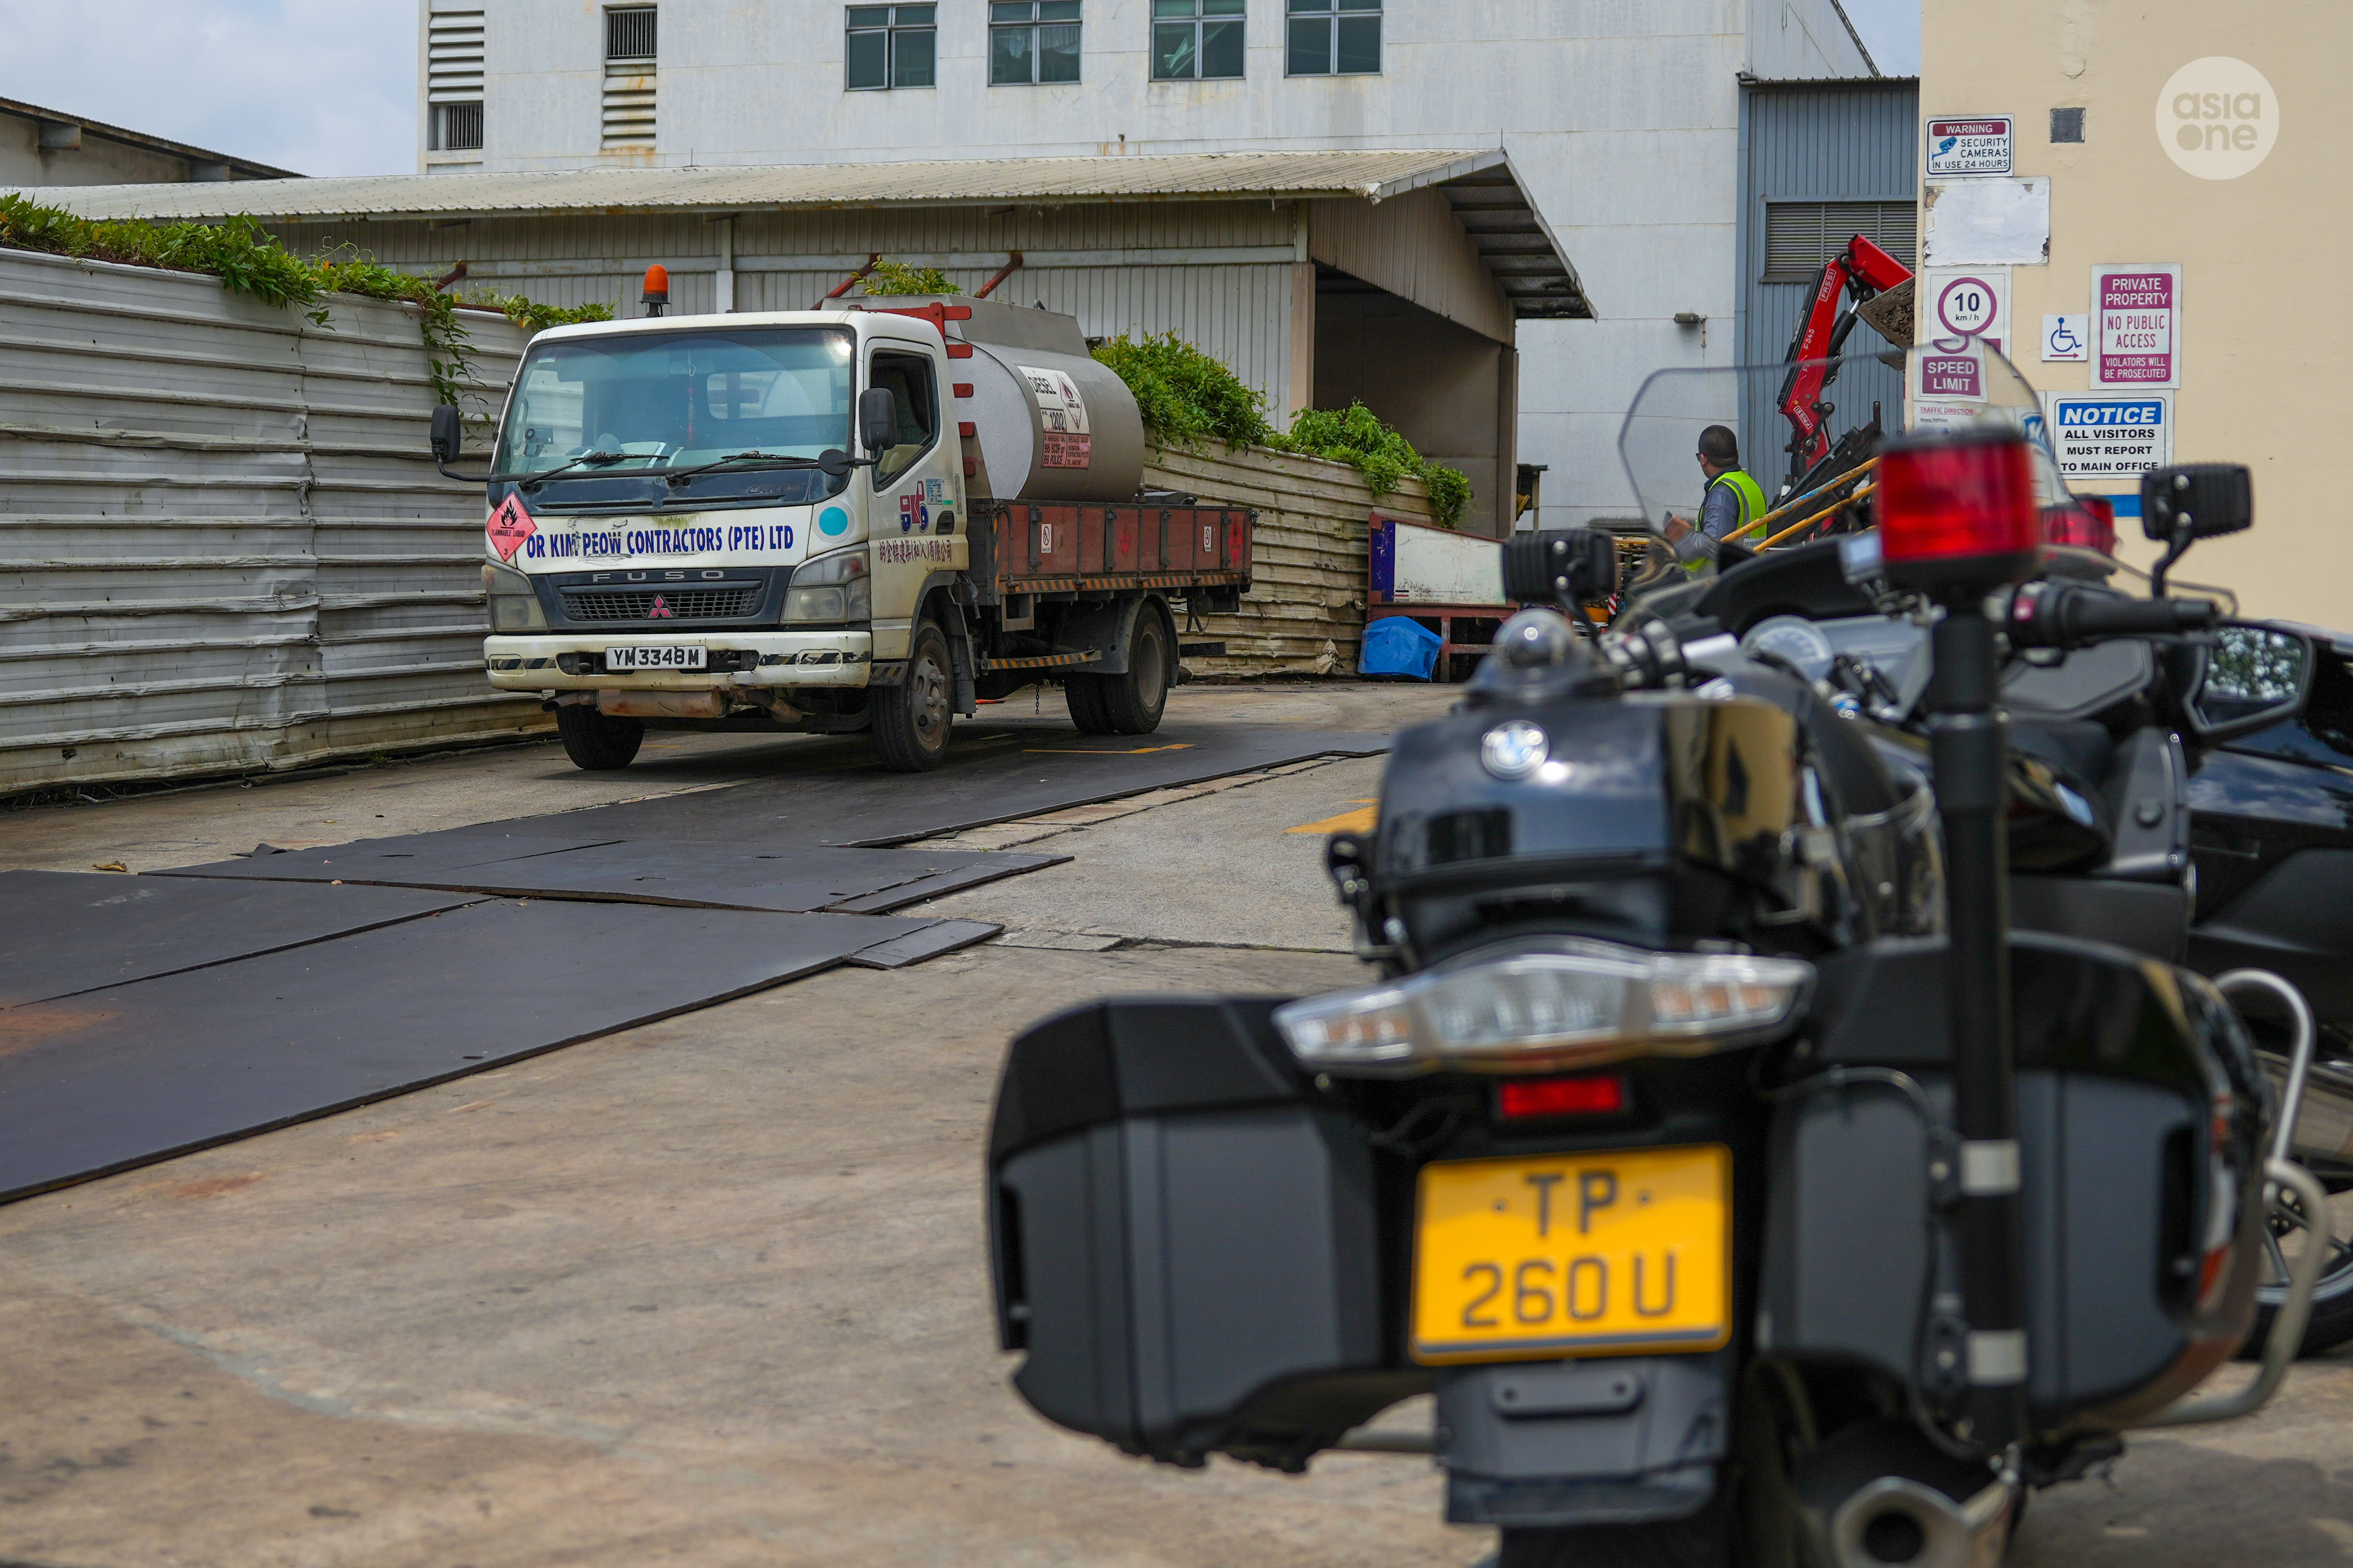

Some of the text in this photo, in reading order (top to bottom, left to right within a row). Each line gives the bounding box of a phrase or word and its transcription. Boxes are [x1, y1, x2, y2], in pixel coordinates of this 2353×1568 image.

[1946, 124, 1993, 134] WARNING
[1960, 138, 2008, 147] SECURITY
[1960, 148, 2008, 157] CAMERAS
[1820, 270, 1835, 300] FASSI
[2112, 278, 2162, 291] PRIVATE
[1955, 293, 1980, 311] 10
[2106, 293, 2168, 306] PROPERTY
[2107, 315, 2165, 330] NO PUBLIC
[2116, 333, 2156, 348] ACCESS
[1928, 362, 1975, 374] SPEED
[2106, 357, 2166, 367] VIOLATORS WILL
[2105, 368, 2166, 378] BE PROSECUTED
[1028, 376, 1057, 394] DIESEL
[1933, 378, 1971, 391] LIMIT
[1049, 411, 1065, 431] 1202
[2064, 406, 2156, 424] NOTICE
[2064, 429, 2155, 438] ALL VISITORS
[2105, 446, 2153, 455] REPORT
[1050, 455, 1063, 464] POLICE
[2081, 462, 2112, 471] MAIN
[2116, 462, 2158, 471] OFFICE
[527, 535, 546, 558] OR
[583, 531, 621, 556] PEOW
[627, 527, 722, 555] CONTRACTORS
[728, 525, 765, 552] (PTE)
[770, 526, 793, 549] LTD
[593, 570, 724, 582] FUSO
[1525, 1170, 1618, 1237] TP
[1461, 1248, 1676, 1328] 260 U
